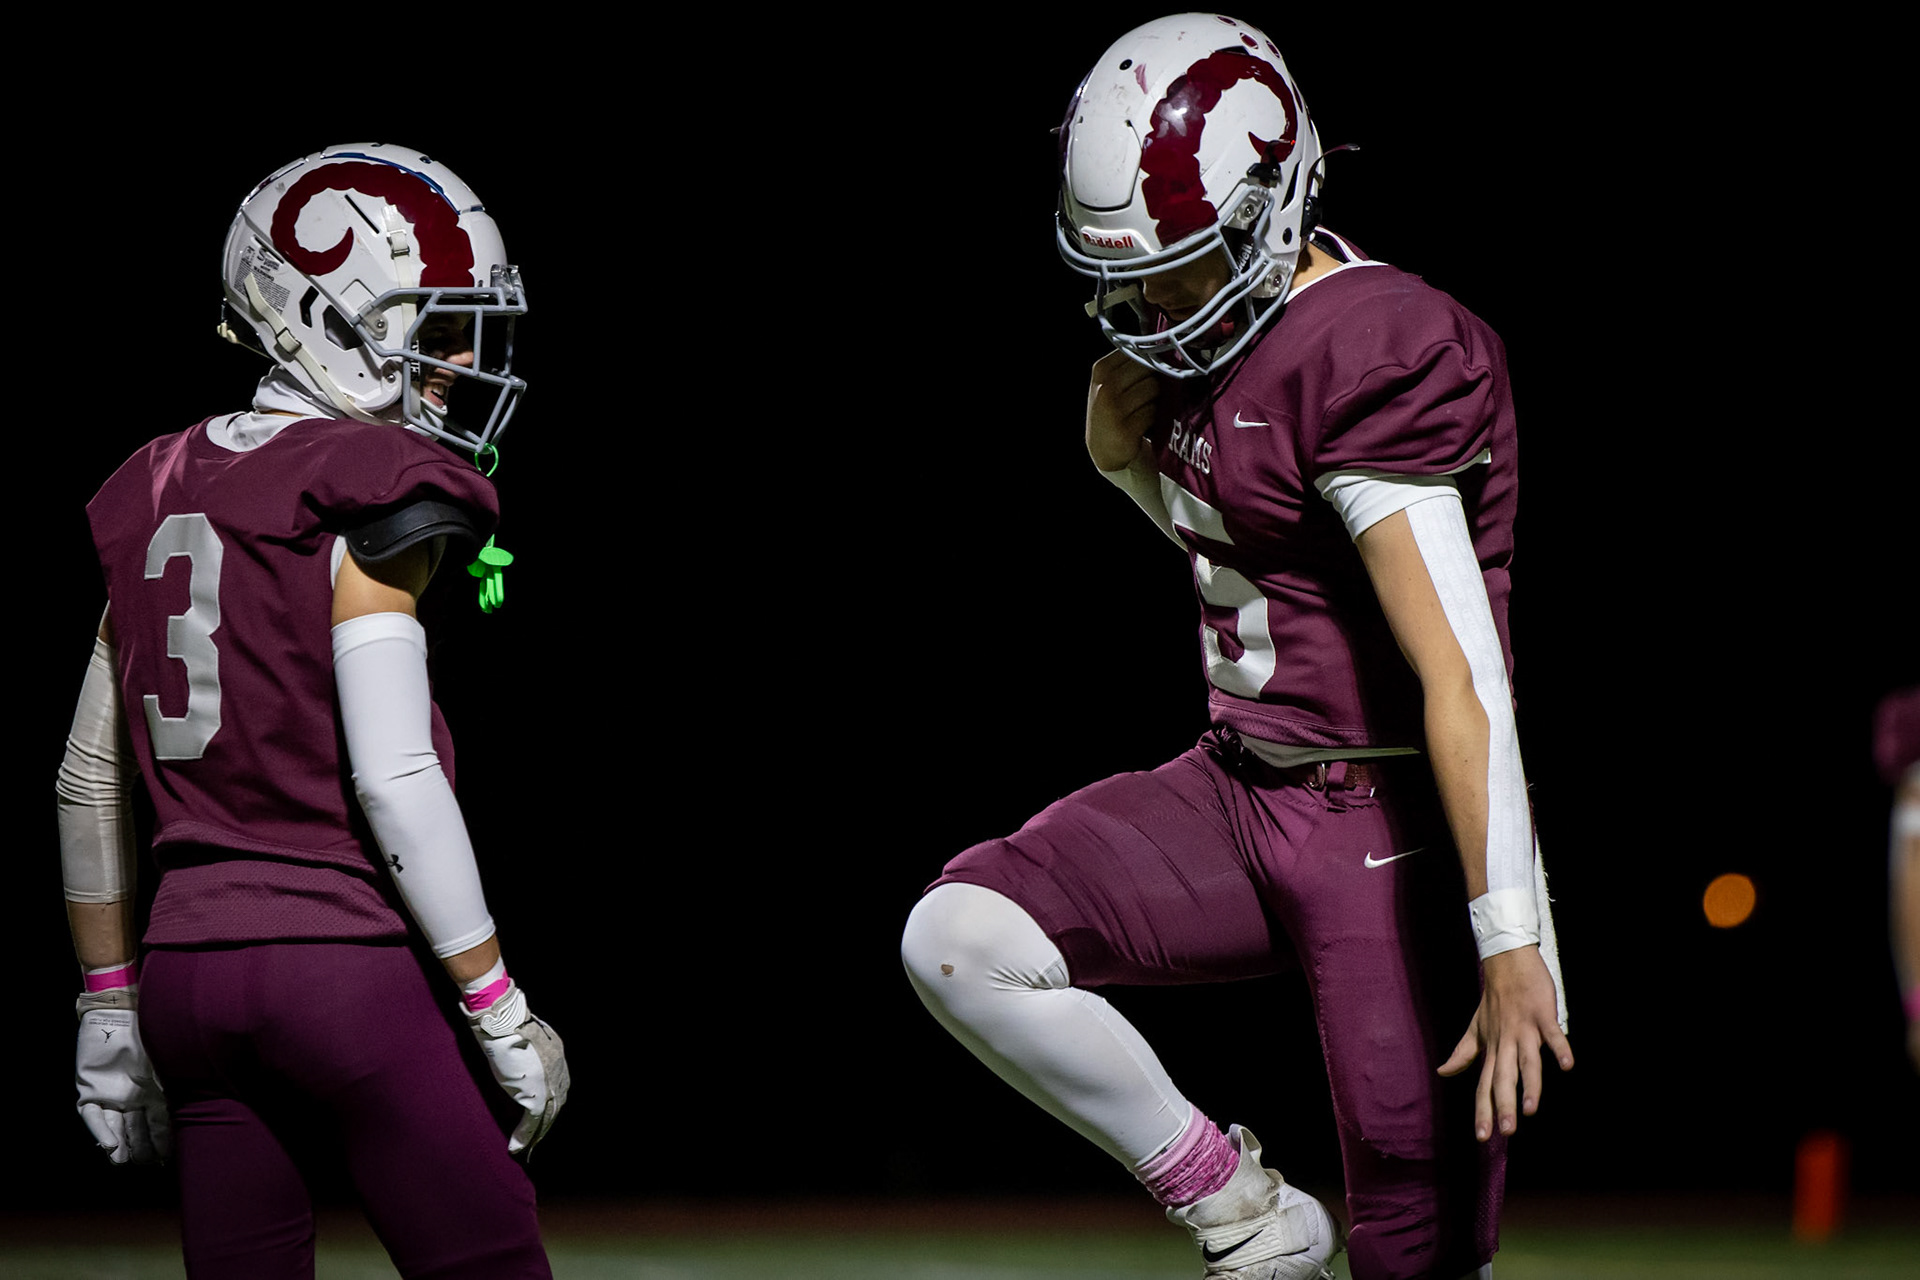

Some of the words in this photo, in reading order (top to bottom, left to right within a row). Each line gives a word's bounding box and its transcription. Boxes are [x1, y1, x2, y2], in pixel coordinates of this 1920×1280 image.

[1081, 231, 1134, 250] Riddell
[1168, 418, 1213, 475] RAMS
[143, 512, 224, 760] 3
[1159, 472, 1276, 700] 5
